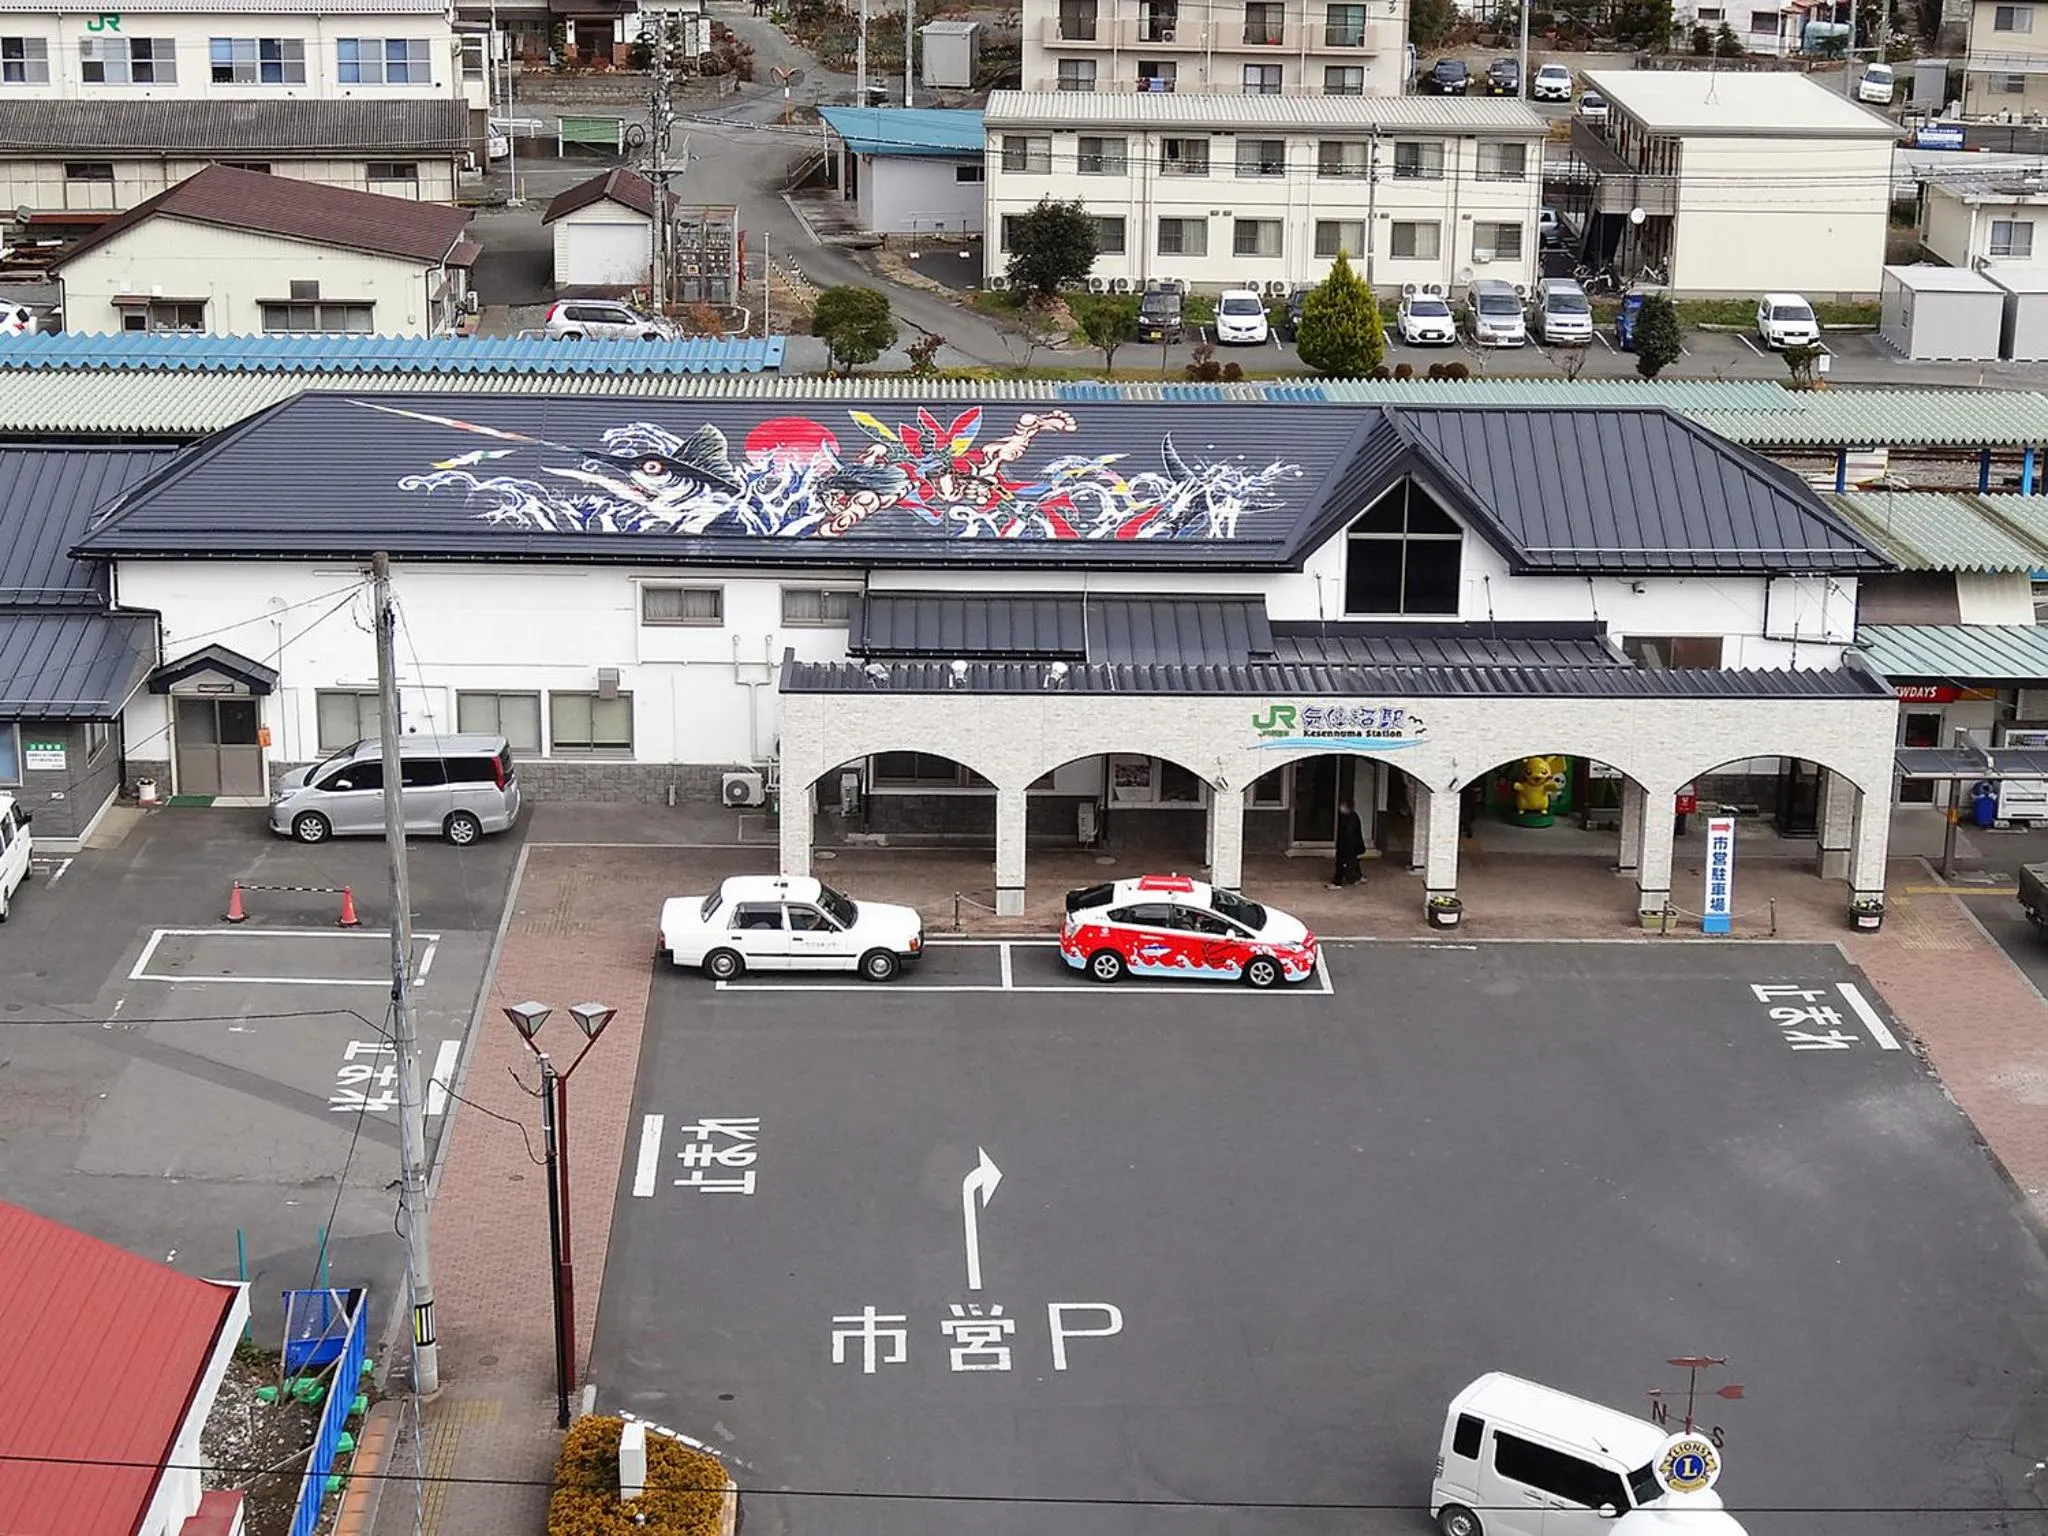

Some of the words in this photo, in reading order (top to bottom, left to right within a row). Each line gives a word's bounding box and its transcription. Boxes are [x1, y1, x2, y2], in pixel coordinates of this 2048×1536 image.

[87, 13, 120, 32] JR
[1252, 705, 1297, 729] JR
[1366, 730, 1403, 738] Station
[1710, 836, 1728, 912] 市営駐車場
[1750, 984, 1860, 1051] 止まれ
[674, 1117, 760, 1195] 止まれ
[1653, 1400, 1667, 1425] N
[1673, 1442, 1707, 1456] LIONS
[1711, 1426, 1724, 1449] S
[1682, 1458, 1698, 1477] L
